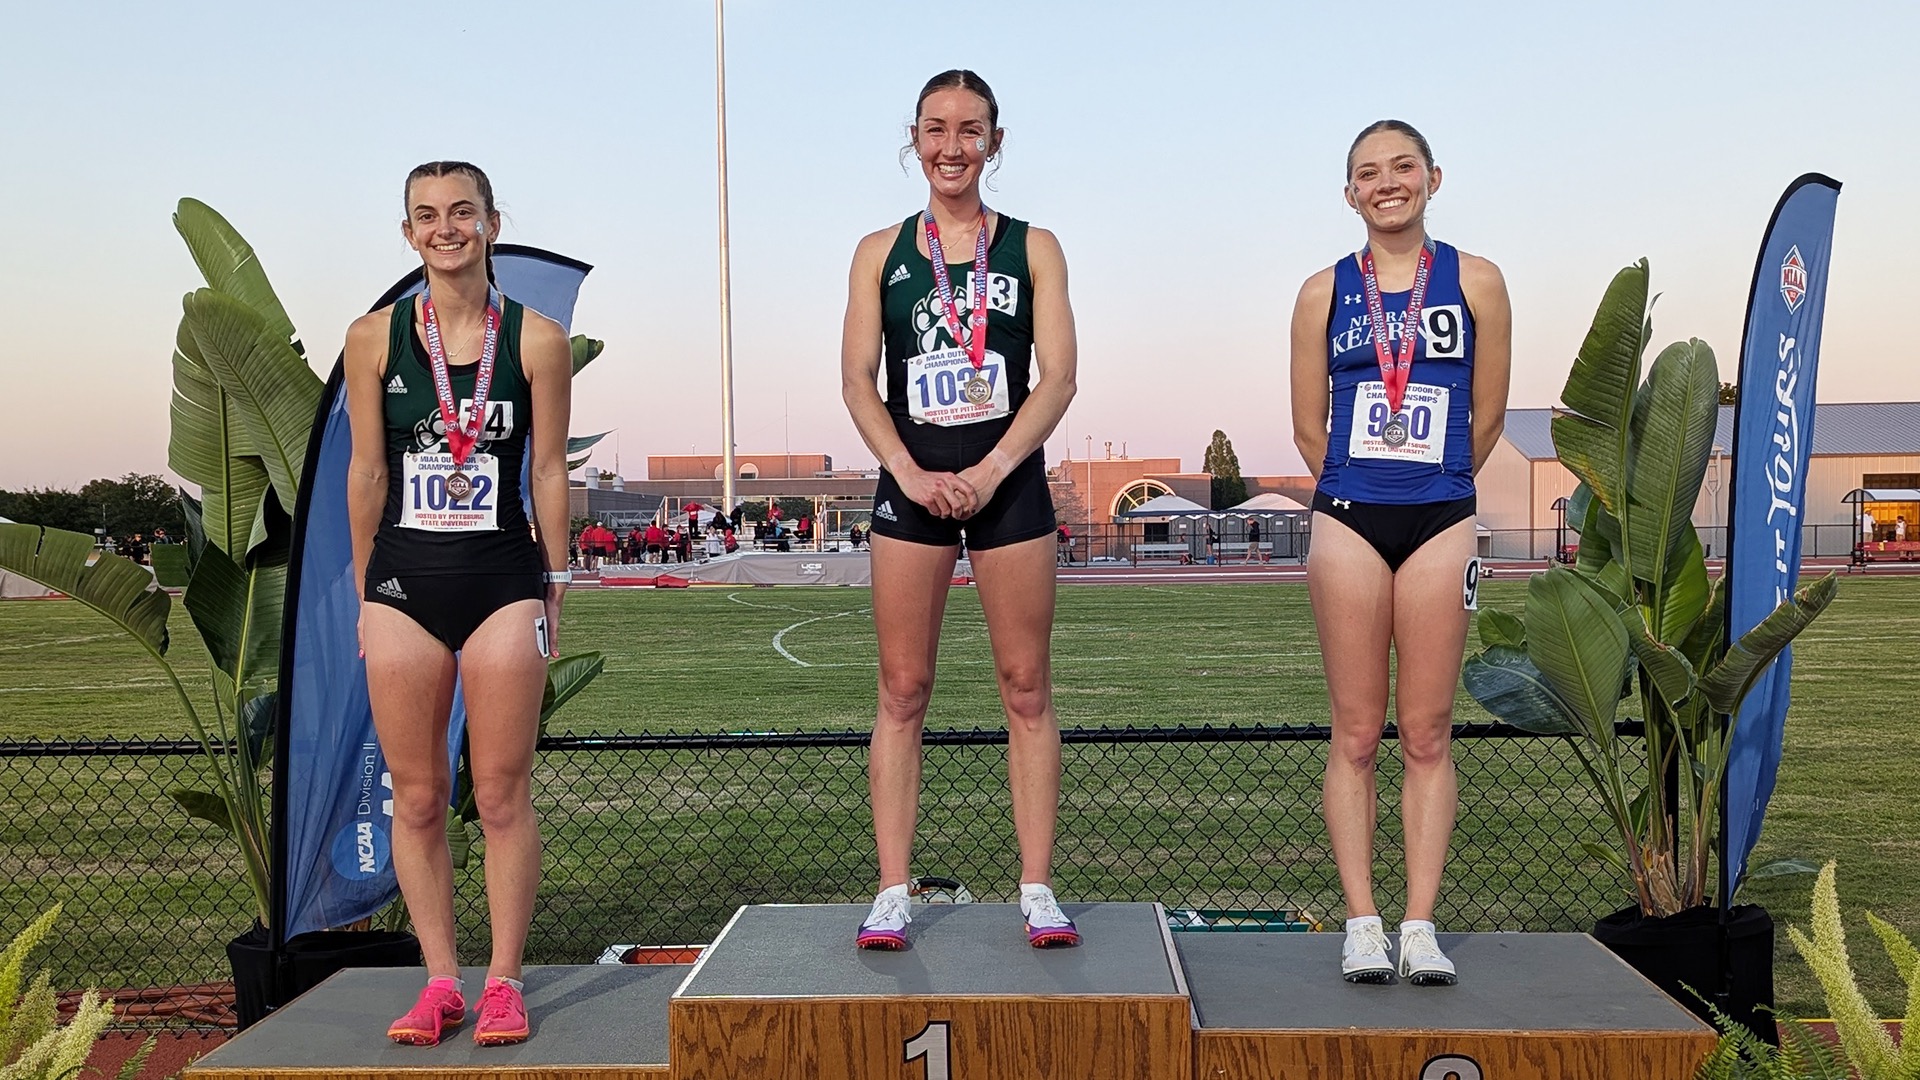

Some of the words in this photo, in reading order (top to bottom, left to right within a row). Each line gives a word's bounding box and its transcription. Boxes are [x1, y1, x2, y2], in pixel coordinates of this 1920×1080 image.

[888, 273, 911, 286] adidas
[1784, 268, 1805, 292] MIAA
[1429, 309, 1458, 354] 9
[924, 357, 971, 369] CHAMPIONS
[926, 354, 945, 362] MIAA
[915, 364, 999, 408] 1037
[1366, 392, 1438, 404] CHANSHIPS
[931, 415, 952, 423] STATE
[953, 411, 989, 420] UNIVERSITY
[1765, 332, 1800, 525] YOURS
[1388, 447, 1425, 455] UNIVERSITY
[441, 456, 476, 464] OUOR
[876, 510, 898, 522] adidas
[1465, 560, 1478, 606] 9
[376, 585, 407, 600] adidas
[357, 755, 376, 815] Division
[357, 821, 376, 873] NCAA
[903, 1020, 952, 1080] 1
